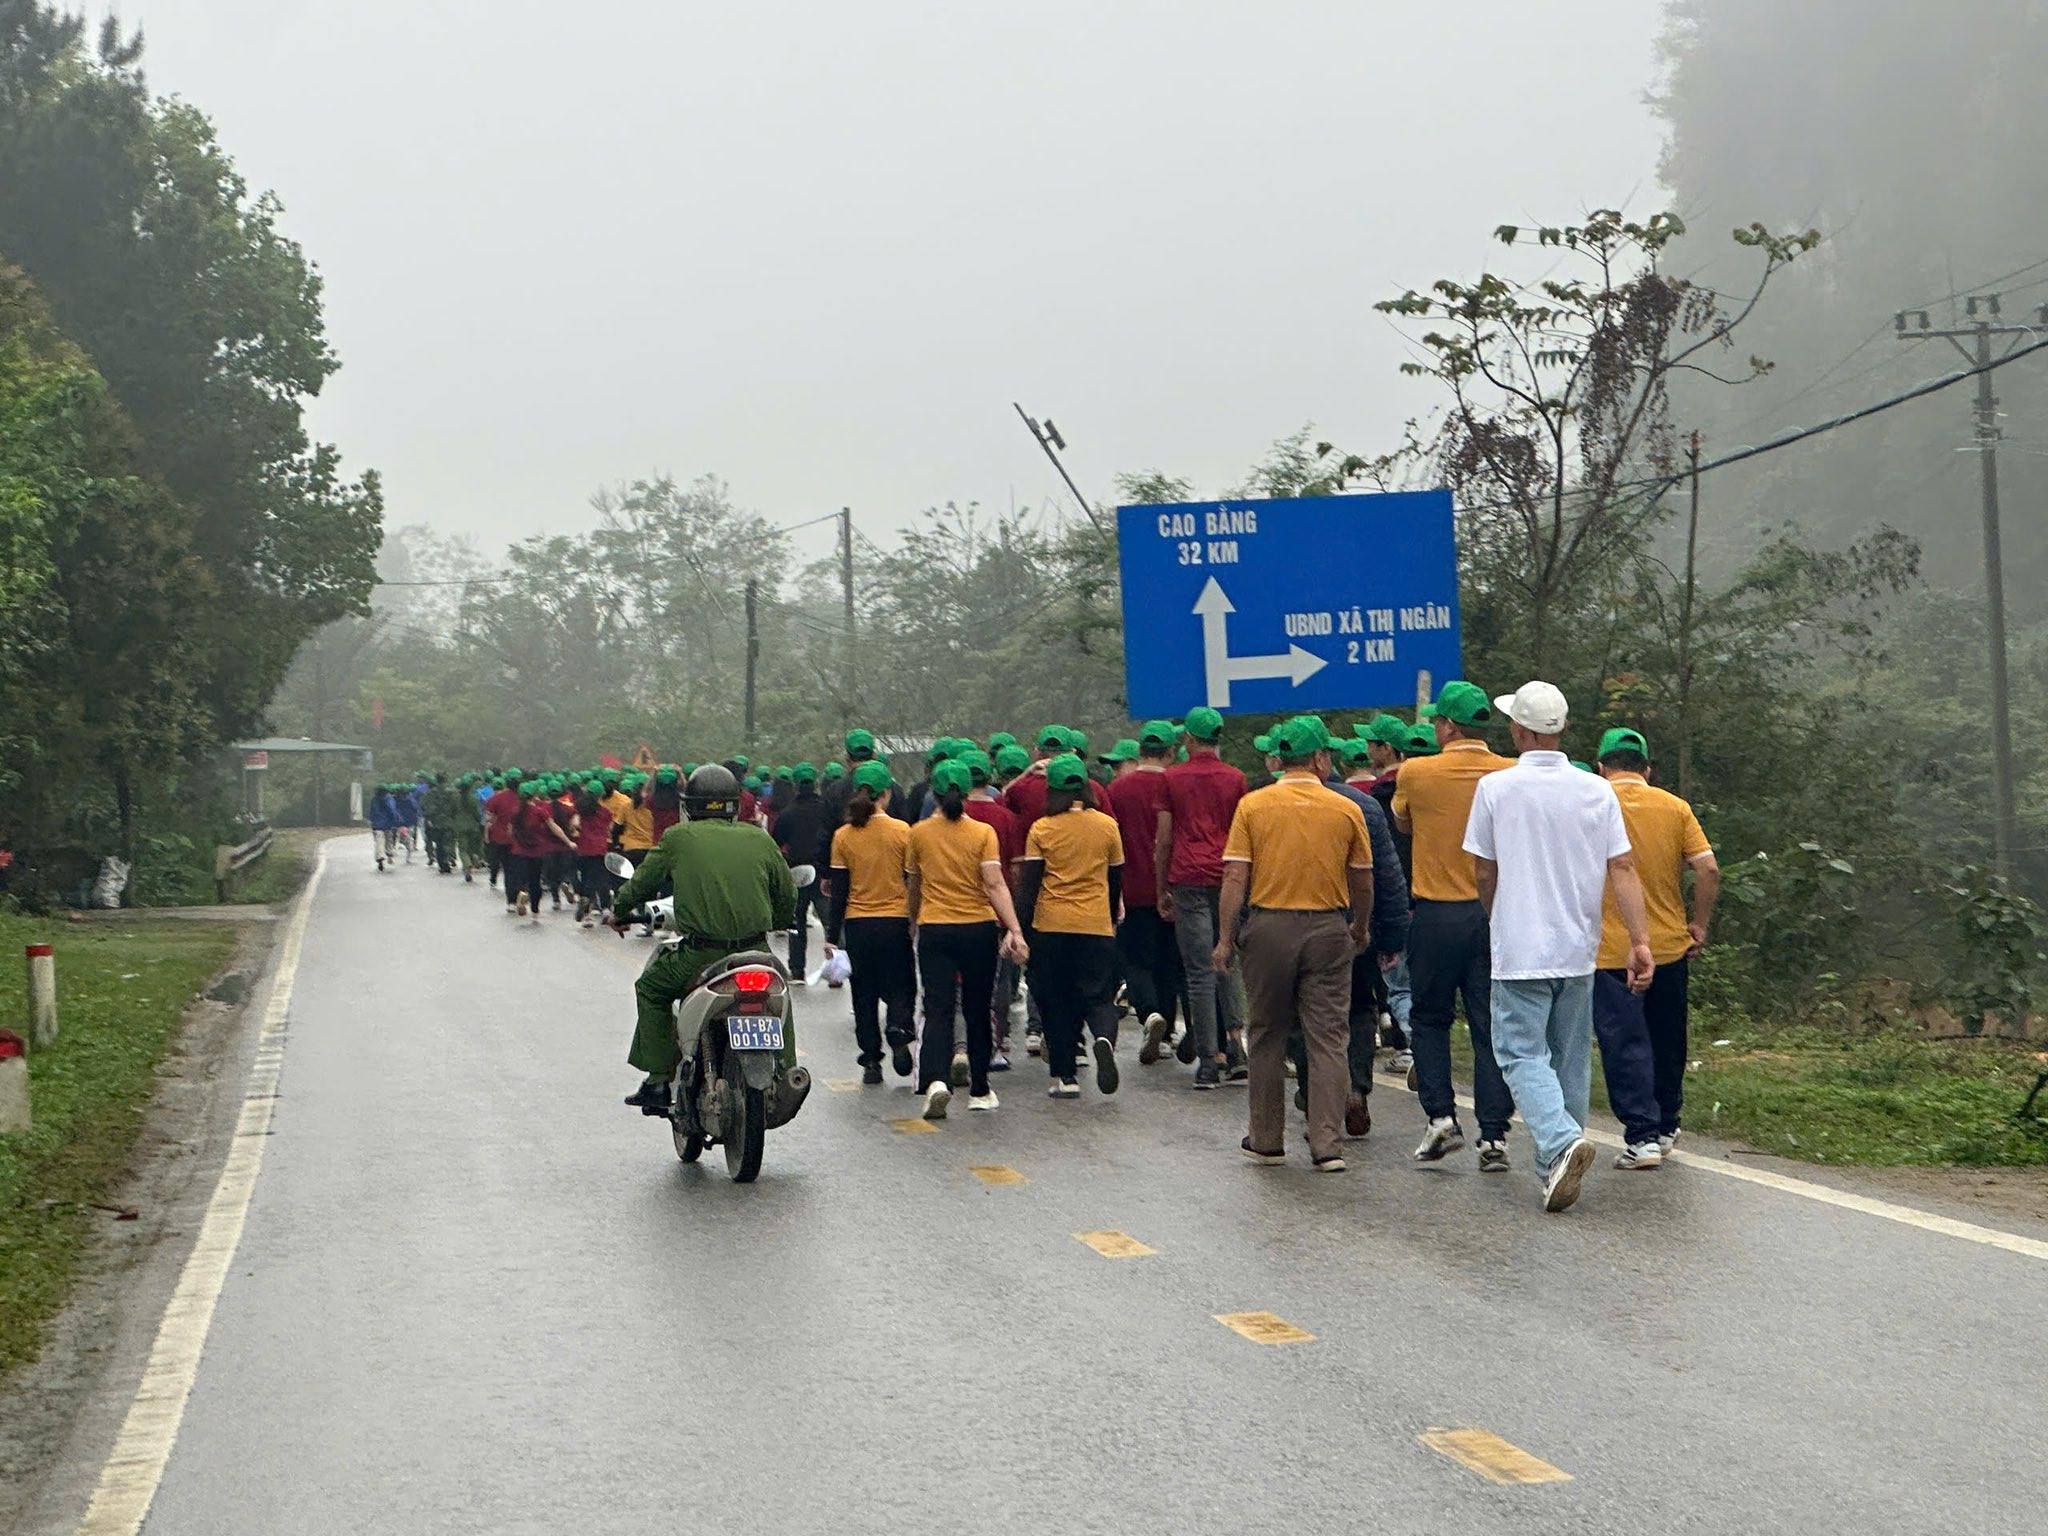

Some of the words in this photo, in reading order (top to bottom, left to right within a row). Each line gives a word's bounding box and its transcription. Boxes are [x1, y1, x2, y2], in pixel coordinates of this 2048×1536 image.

[1158, 513, 1196, 537] CAO
[1178, 542, 1202, 565] 32
[1207, 541, 1239, 564] KM
[1285, 612, 1333, 637] UBND
[1338, 605, 1364, 634] XÃ
[1366, 609, 1395, 636] THỊ
[1400, 602, 1450, 631] NGÂN
[1347, 640, 1360, 664] 2
[1364, 638, 1395, 662] KM
